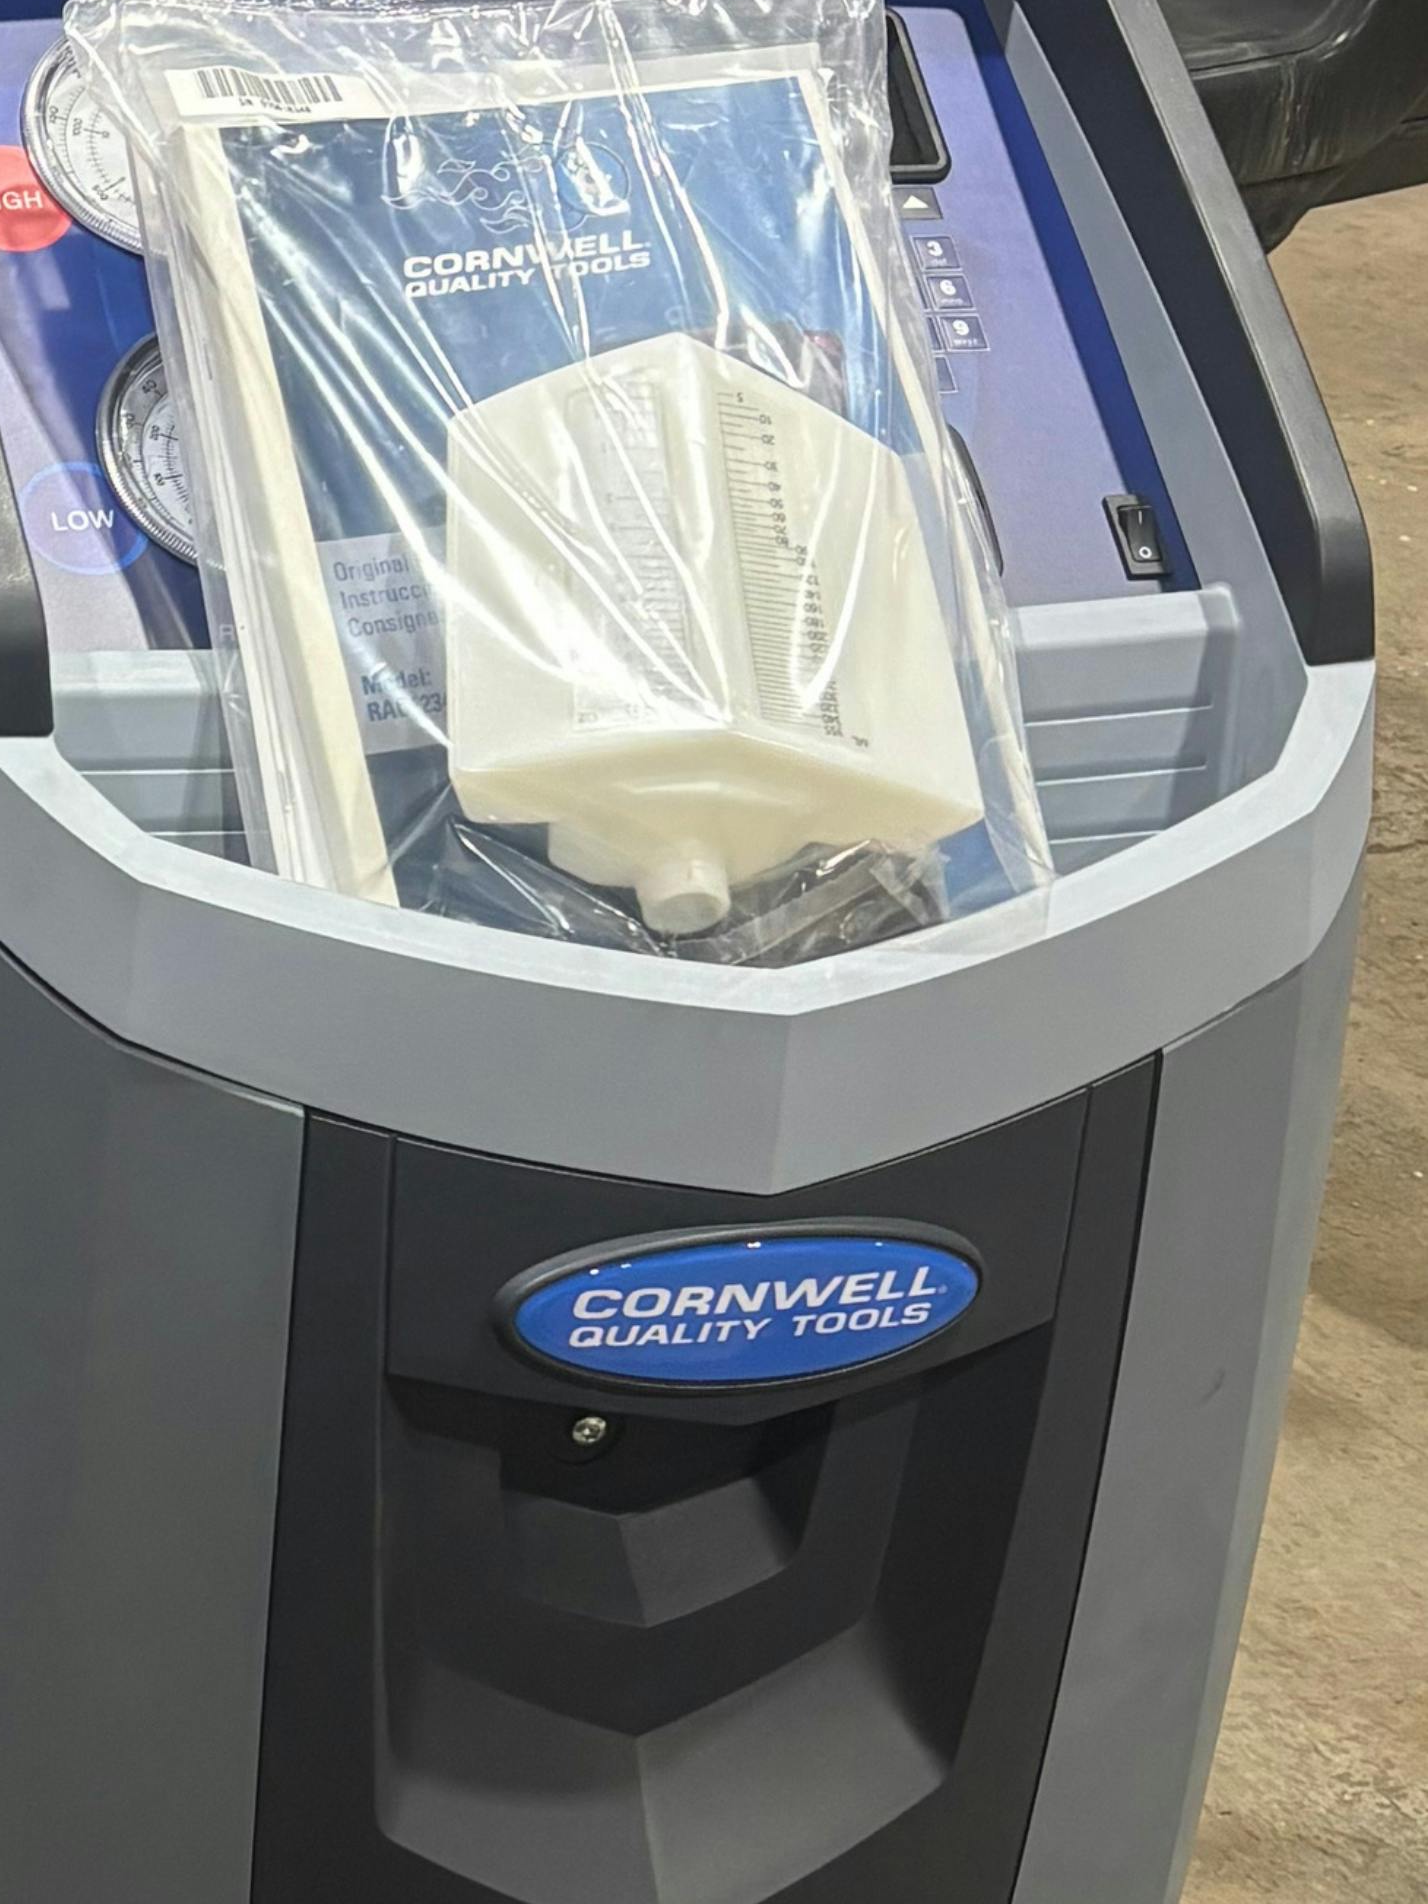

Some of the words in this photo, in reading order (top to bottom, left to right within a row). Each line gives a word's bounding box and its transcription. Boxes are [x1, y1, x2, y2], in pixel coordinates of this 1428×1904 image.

[403, 229, 644, 279] CORNWELL
[926, 240, 943, 257] 3
[404, 268, 535, 298] QUALITY
[549, 251, 651, 280] TOOLS
[939, 279, 957, 296] 6
[952, 319, 970, 336] 9
[51, 509, 114, 532] LOW
[333, 554, 410, 582] Original
[361, 668, 433, 696] Mdel:
[572, 1266, 938, 1321] CORNWELL
[568, 1318, 771, 1349] QUALITY
[791, 1302, 931, 1337] TOOLS
